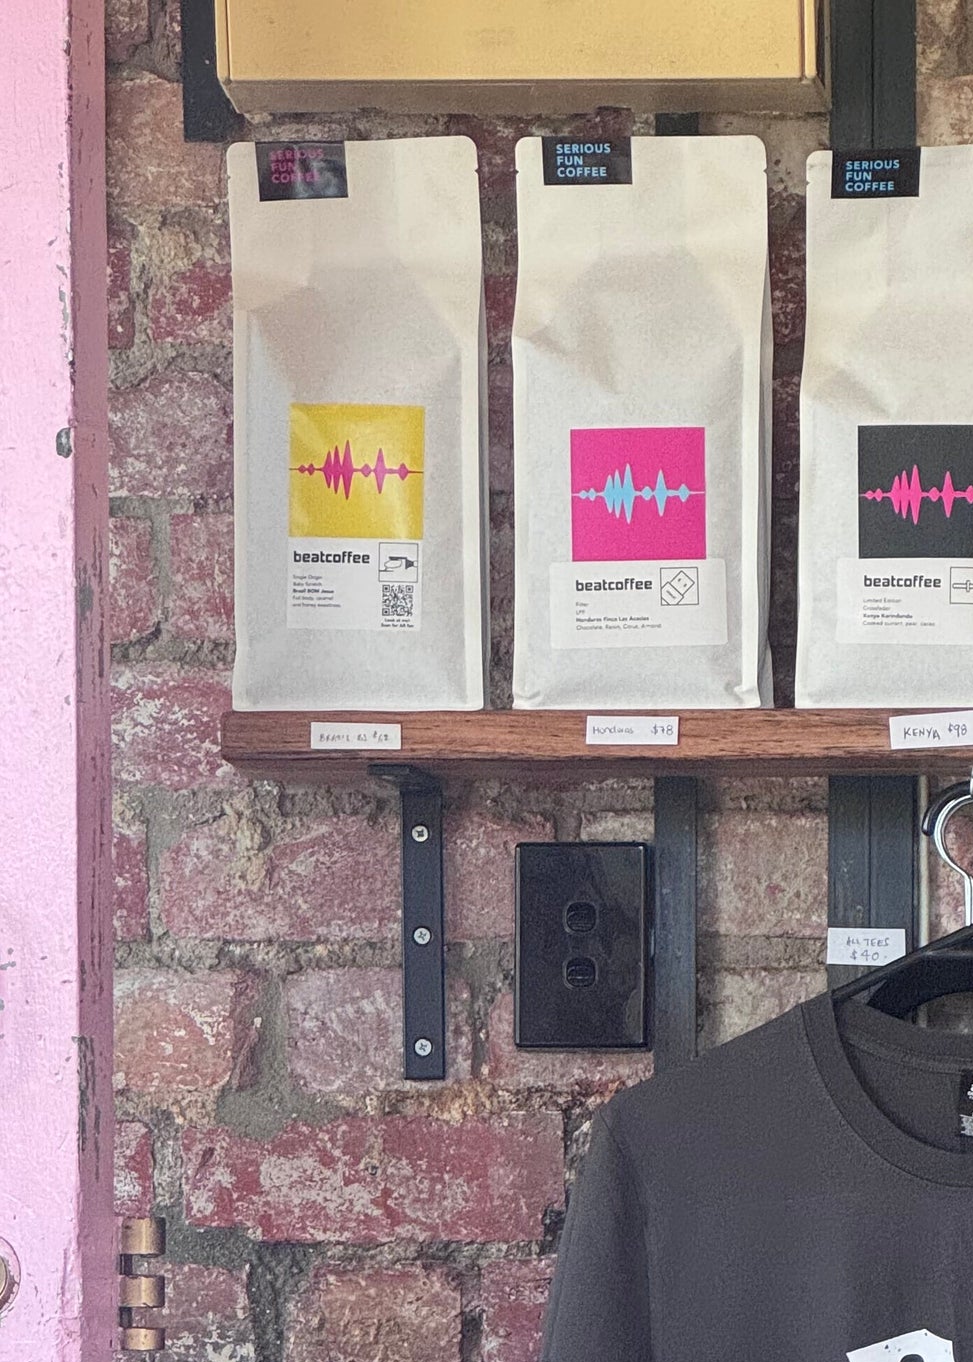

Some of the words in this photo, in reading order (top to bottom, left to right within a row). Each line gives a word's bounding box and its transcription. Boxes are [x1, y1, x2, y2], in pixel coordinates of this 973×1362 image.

[556, 143, 611, 154] SERIOUS
[556, 155, 583, 166] FUN
[845, 159, 900, 170] SERIOUS
[557, 166, 607, 177] COFFEE
[845, 171, 872, 181] FUN
[845, 181, 895, 192] COFFEE
[293, 550, 370, 564] beatcoffee
[575, 578, 653, 592] beatcoffee
[864, 575, 942, 588] beatcoffee
[592, 726, 634, 735] Honduras
[903, 726, 941, 740] KENYA
[948, 723, 968, 738] $98
[846, 936, 860, 946] ALL
[863, 937, 890, 947] TEES
